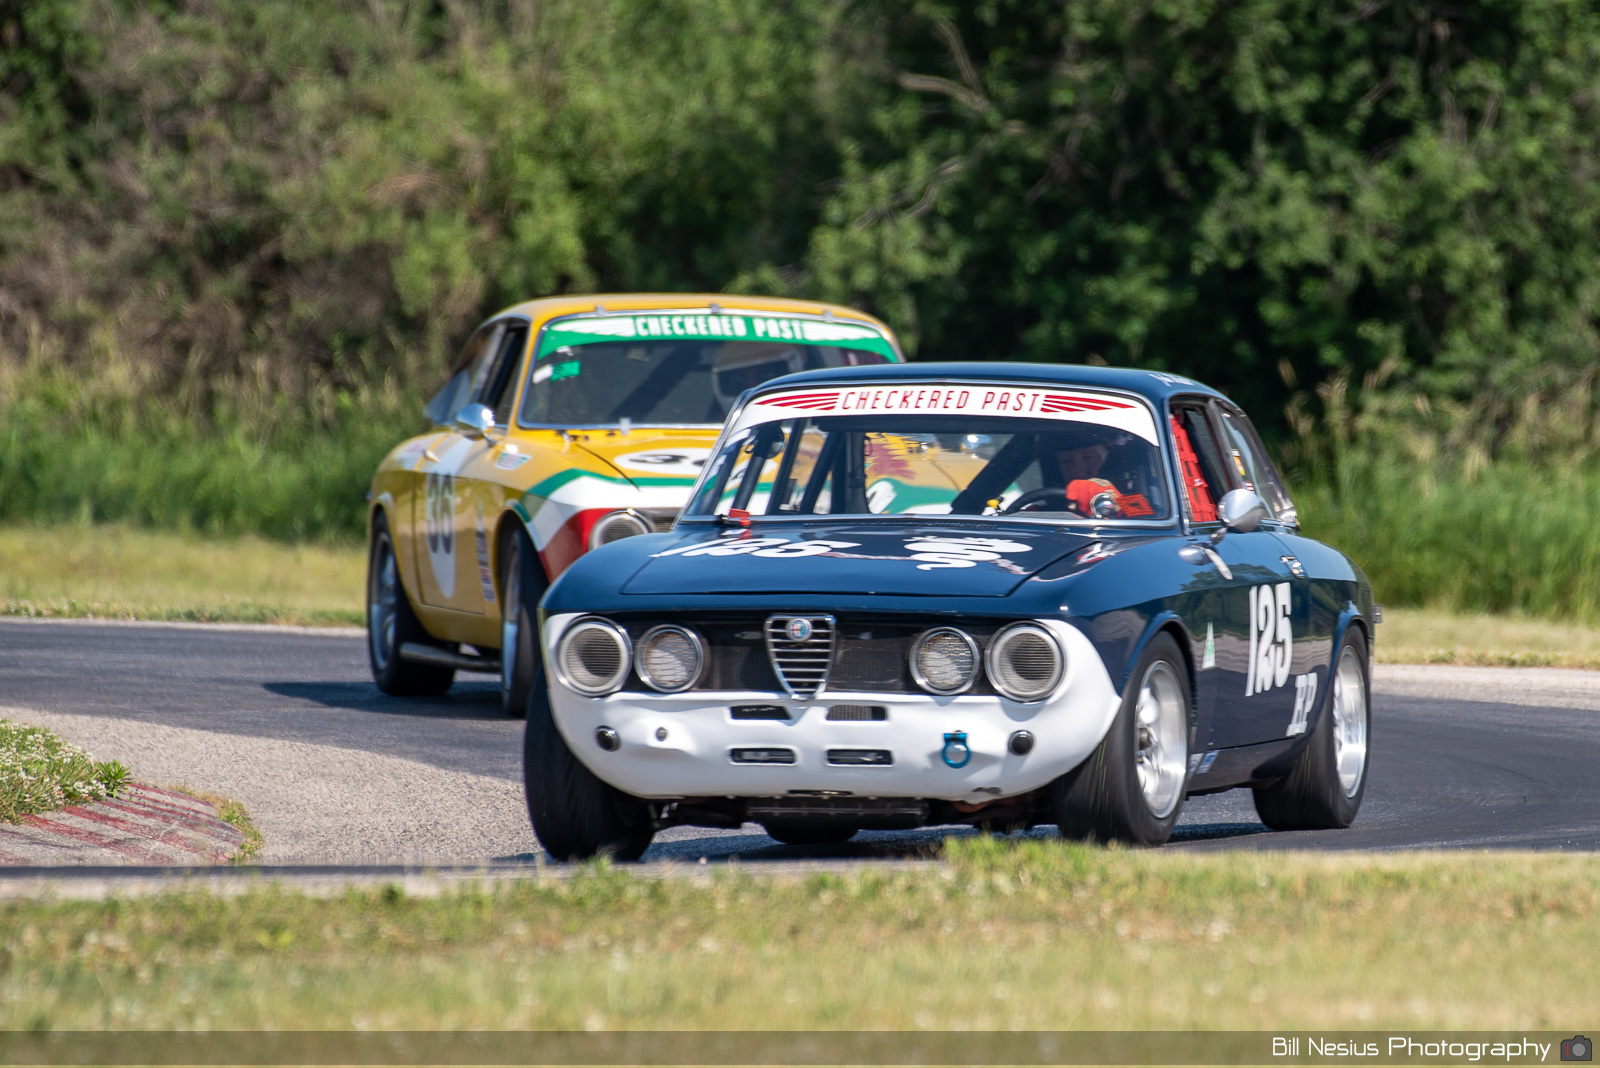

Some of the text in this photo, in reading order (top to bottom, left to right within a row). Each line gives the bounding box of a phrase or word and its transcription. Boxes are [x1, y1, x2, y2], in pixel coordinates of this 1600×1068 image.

[635, 315, 804, 340] CHECKERED PAST
[841, 390, 1040, 412] CHECKERED PAST
[648, 537, 862, 558] 125
[1245, 582, 1293, 697] 125
